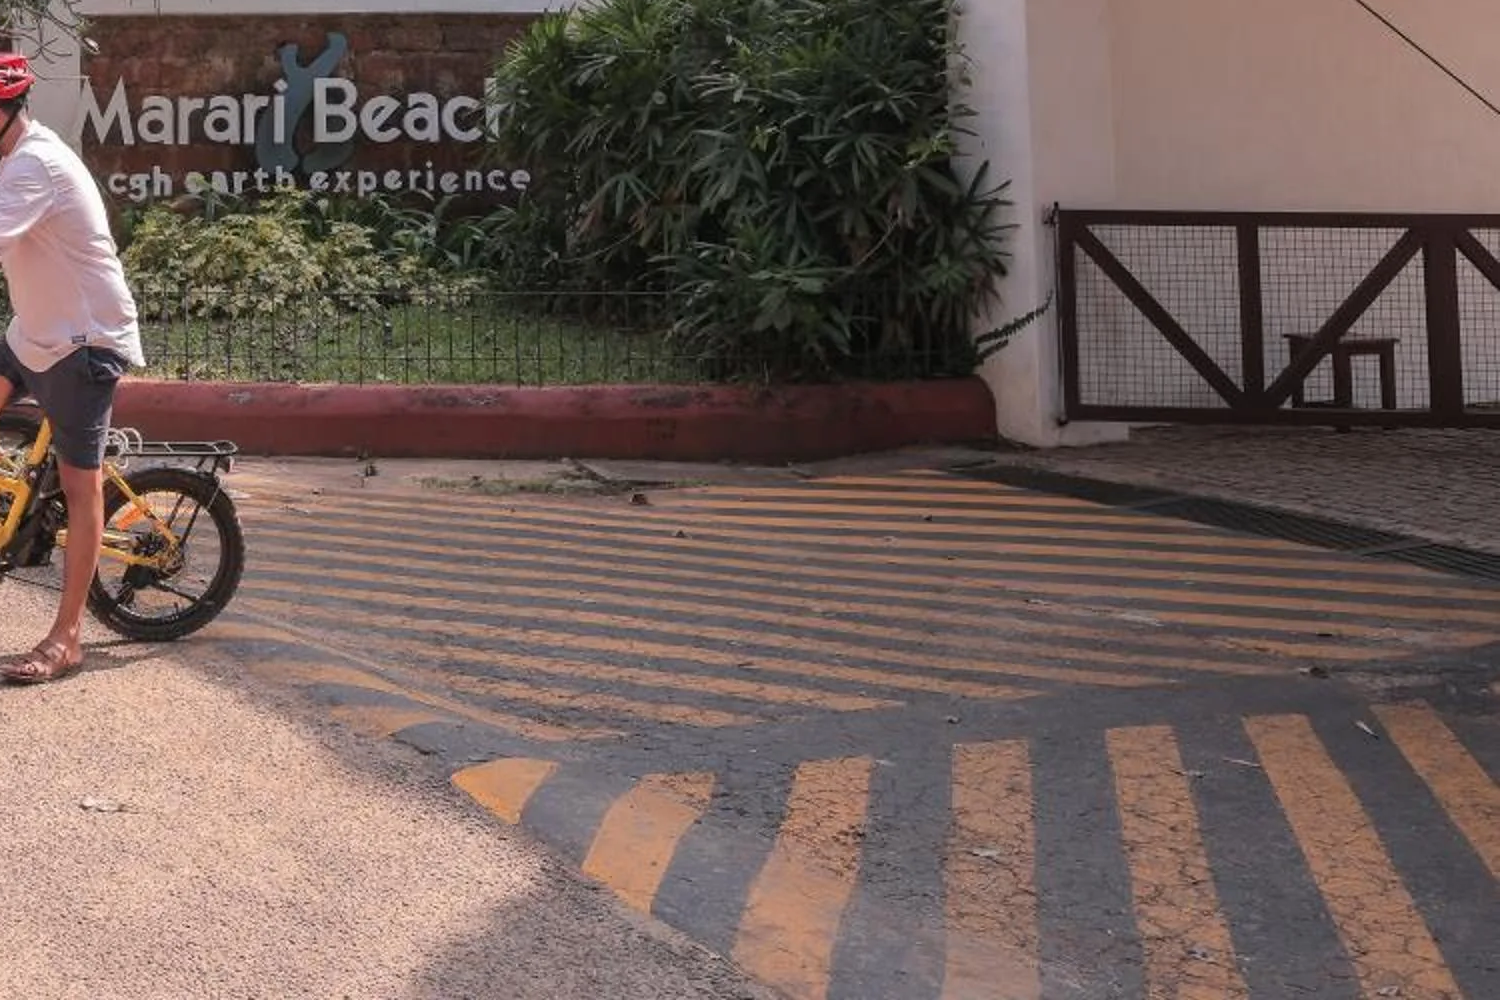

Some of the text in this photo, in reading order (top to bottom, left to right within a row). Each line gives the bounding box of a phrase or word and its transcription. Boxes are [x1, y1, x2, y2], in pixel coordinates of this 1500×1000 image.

[76, 74, 288, 145] Marari
[108, 165, 173, 201] cgh
[309, 160, 531, 197] experience
